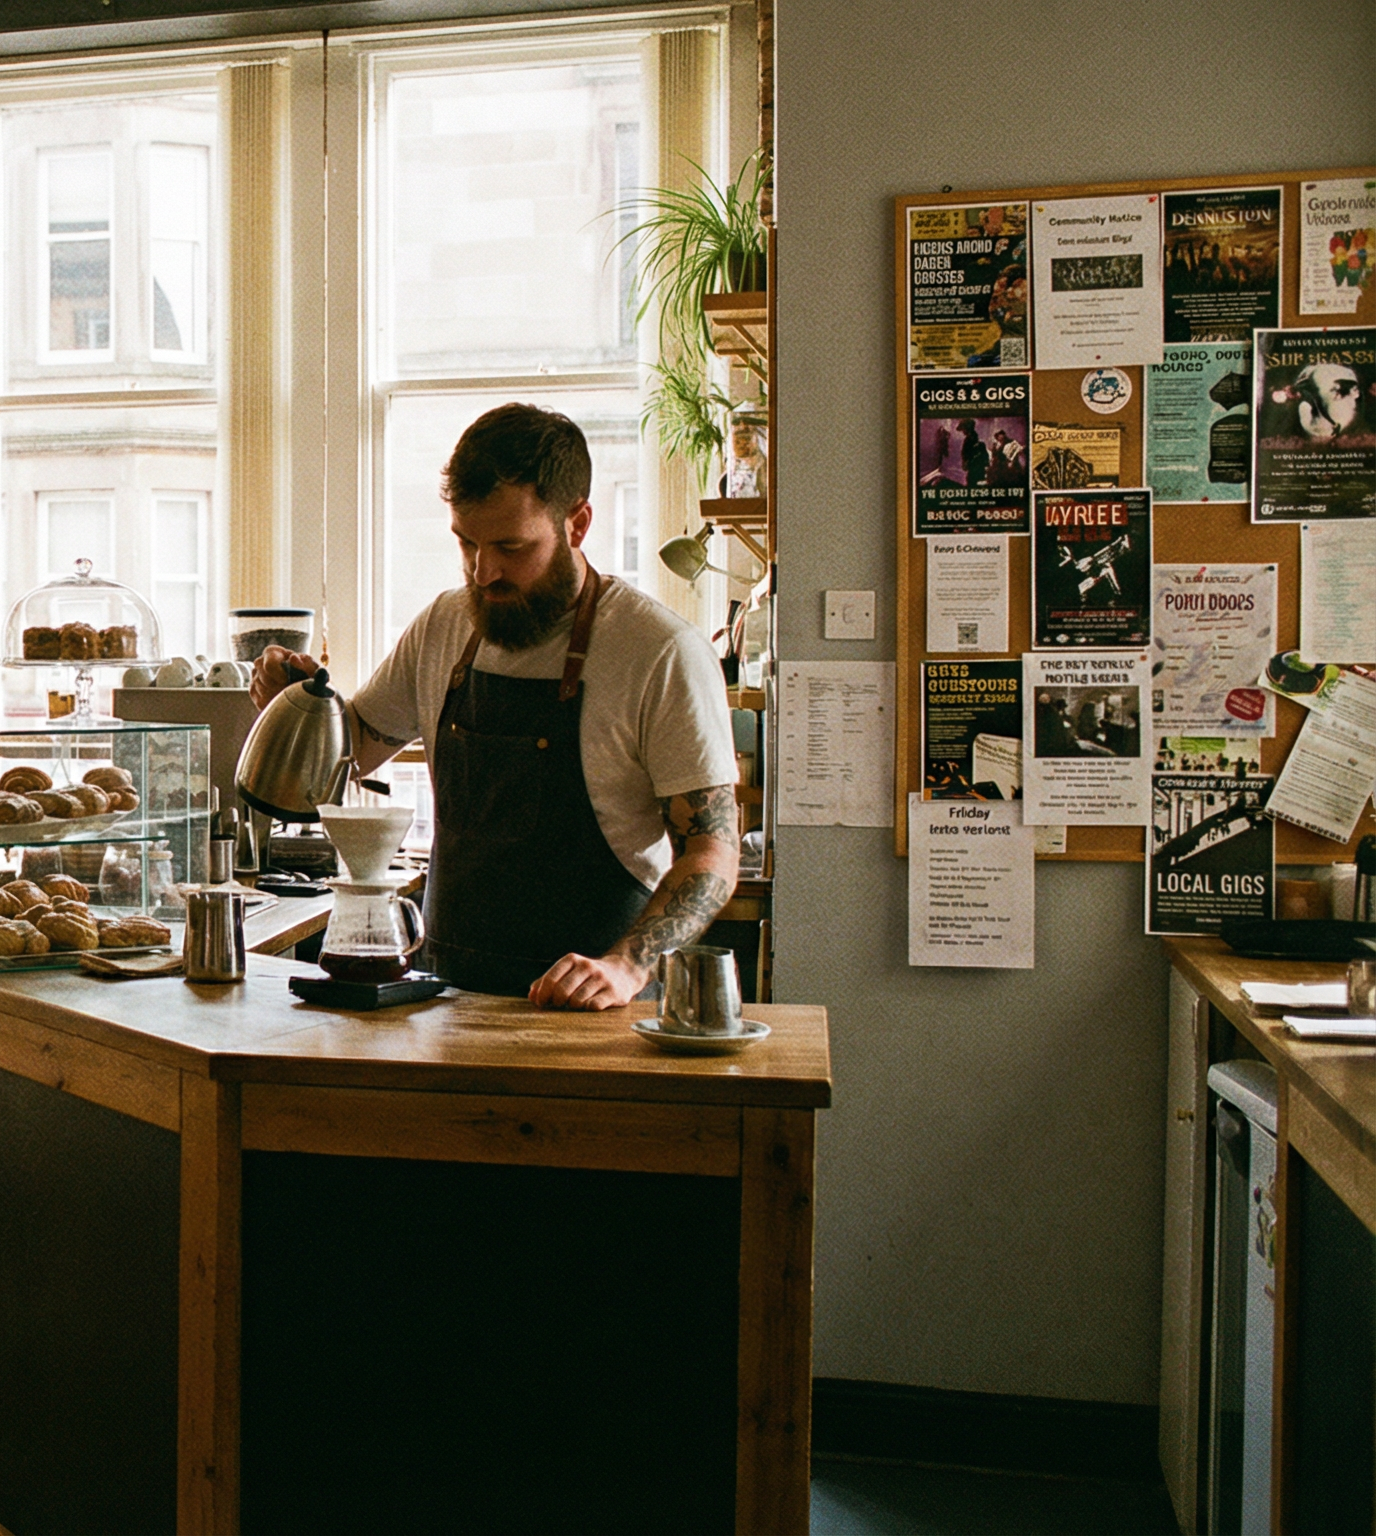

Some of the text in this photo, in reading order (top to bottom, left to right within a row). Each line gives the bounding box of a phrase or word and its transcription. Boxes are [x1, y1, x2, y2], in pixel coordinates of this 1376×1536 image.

[920, 389, 955, 402] GIGS
[985, 387, 1026, 401] GIGS
[1157, 872, 1265, 895] LOCAL GIGS
